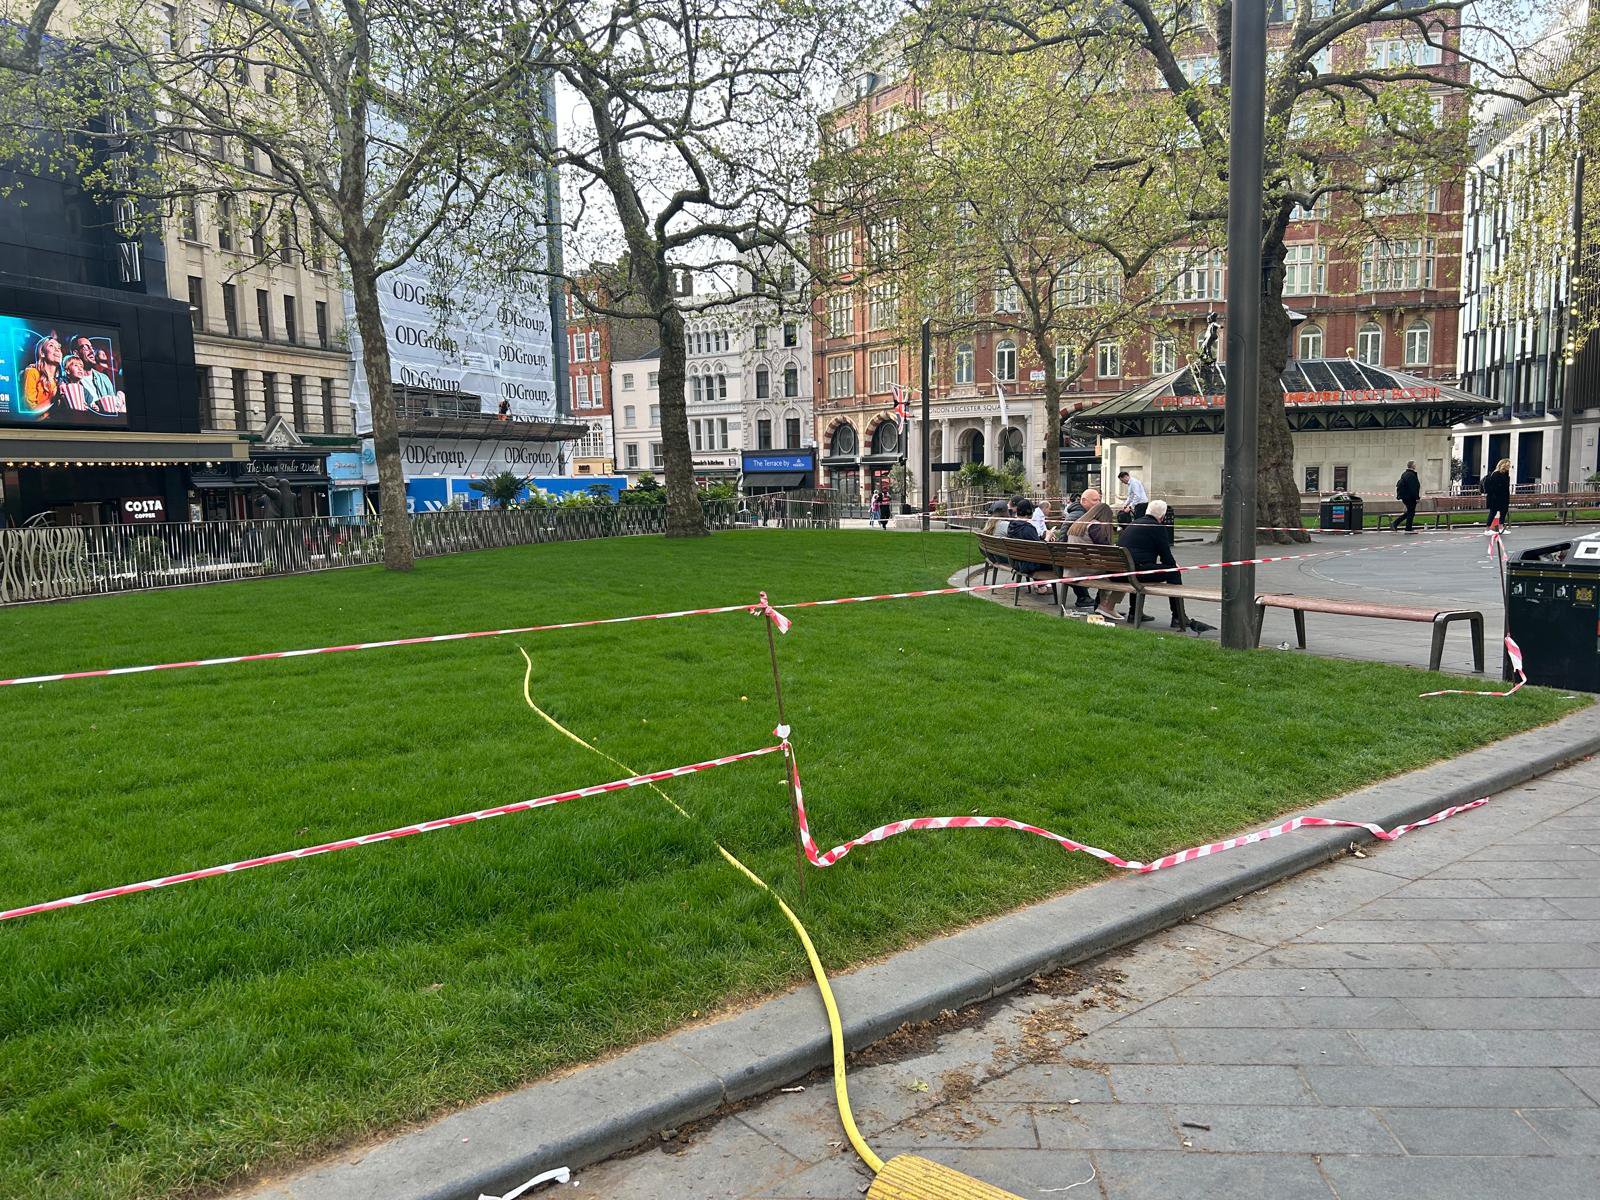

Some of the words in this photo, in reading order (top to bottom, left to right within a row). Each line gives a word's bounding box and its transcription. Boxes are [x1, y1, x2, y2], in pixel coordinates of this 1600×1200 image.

[499, 344, 548, 371] ODGroup.
[500, 382, 550, 406] ODGroup.
[1342, 388, 1387, 400] TICKET
[1392, 385, 1440, 400] BOOTH
[983, 403, 1009, 411] SQUAE
[406, 445, 467, 468] ODGroup.
[504, 446, 554, 468] ODGroup.
[753, 459, 763, 467] The
[764, 459, 782, 467] Terrace
[783, 459, 790, 468] by
[246, 459, 260, 473] The
[262, 463, 279, 473] Moon
[280, 459, 299, 472] Under
[301, 462, 320, 472] Water
[125, 500, 163, 512] COSTA
